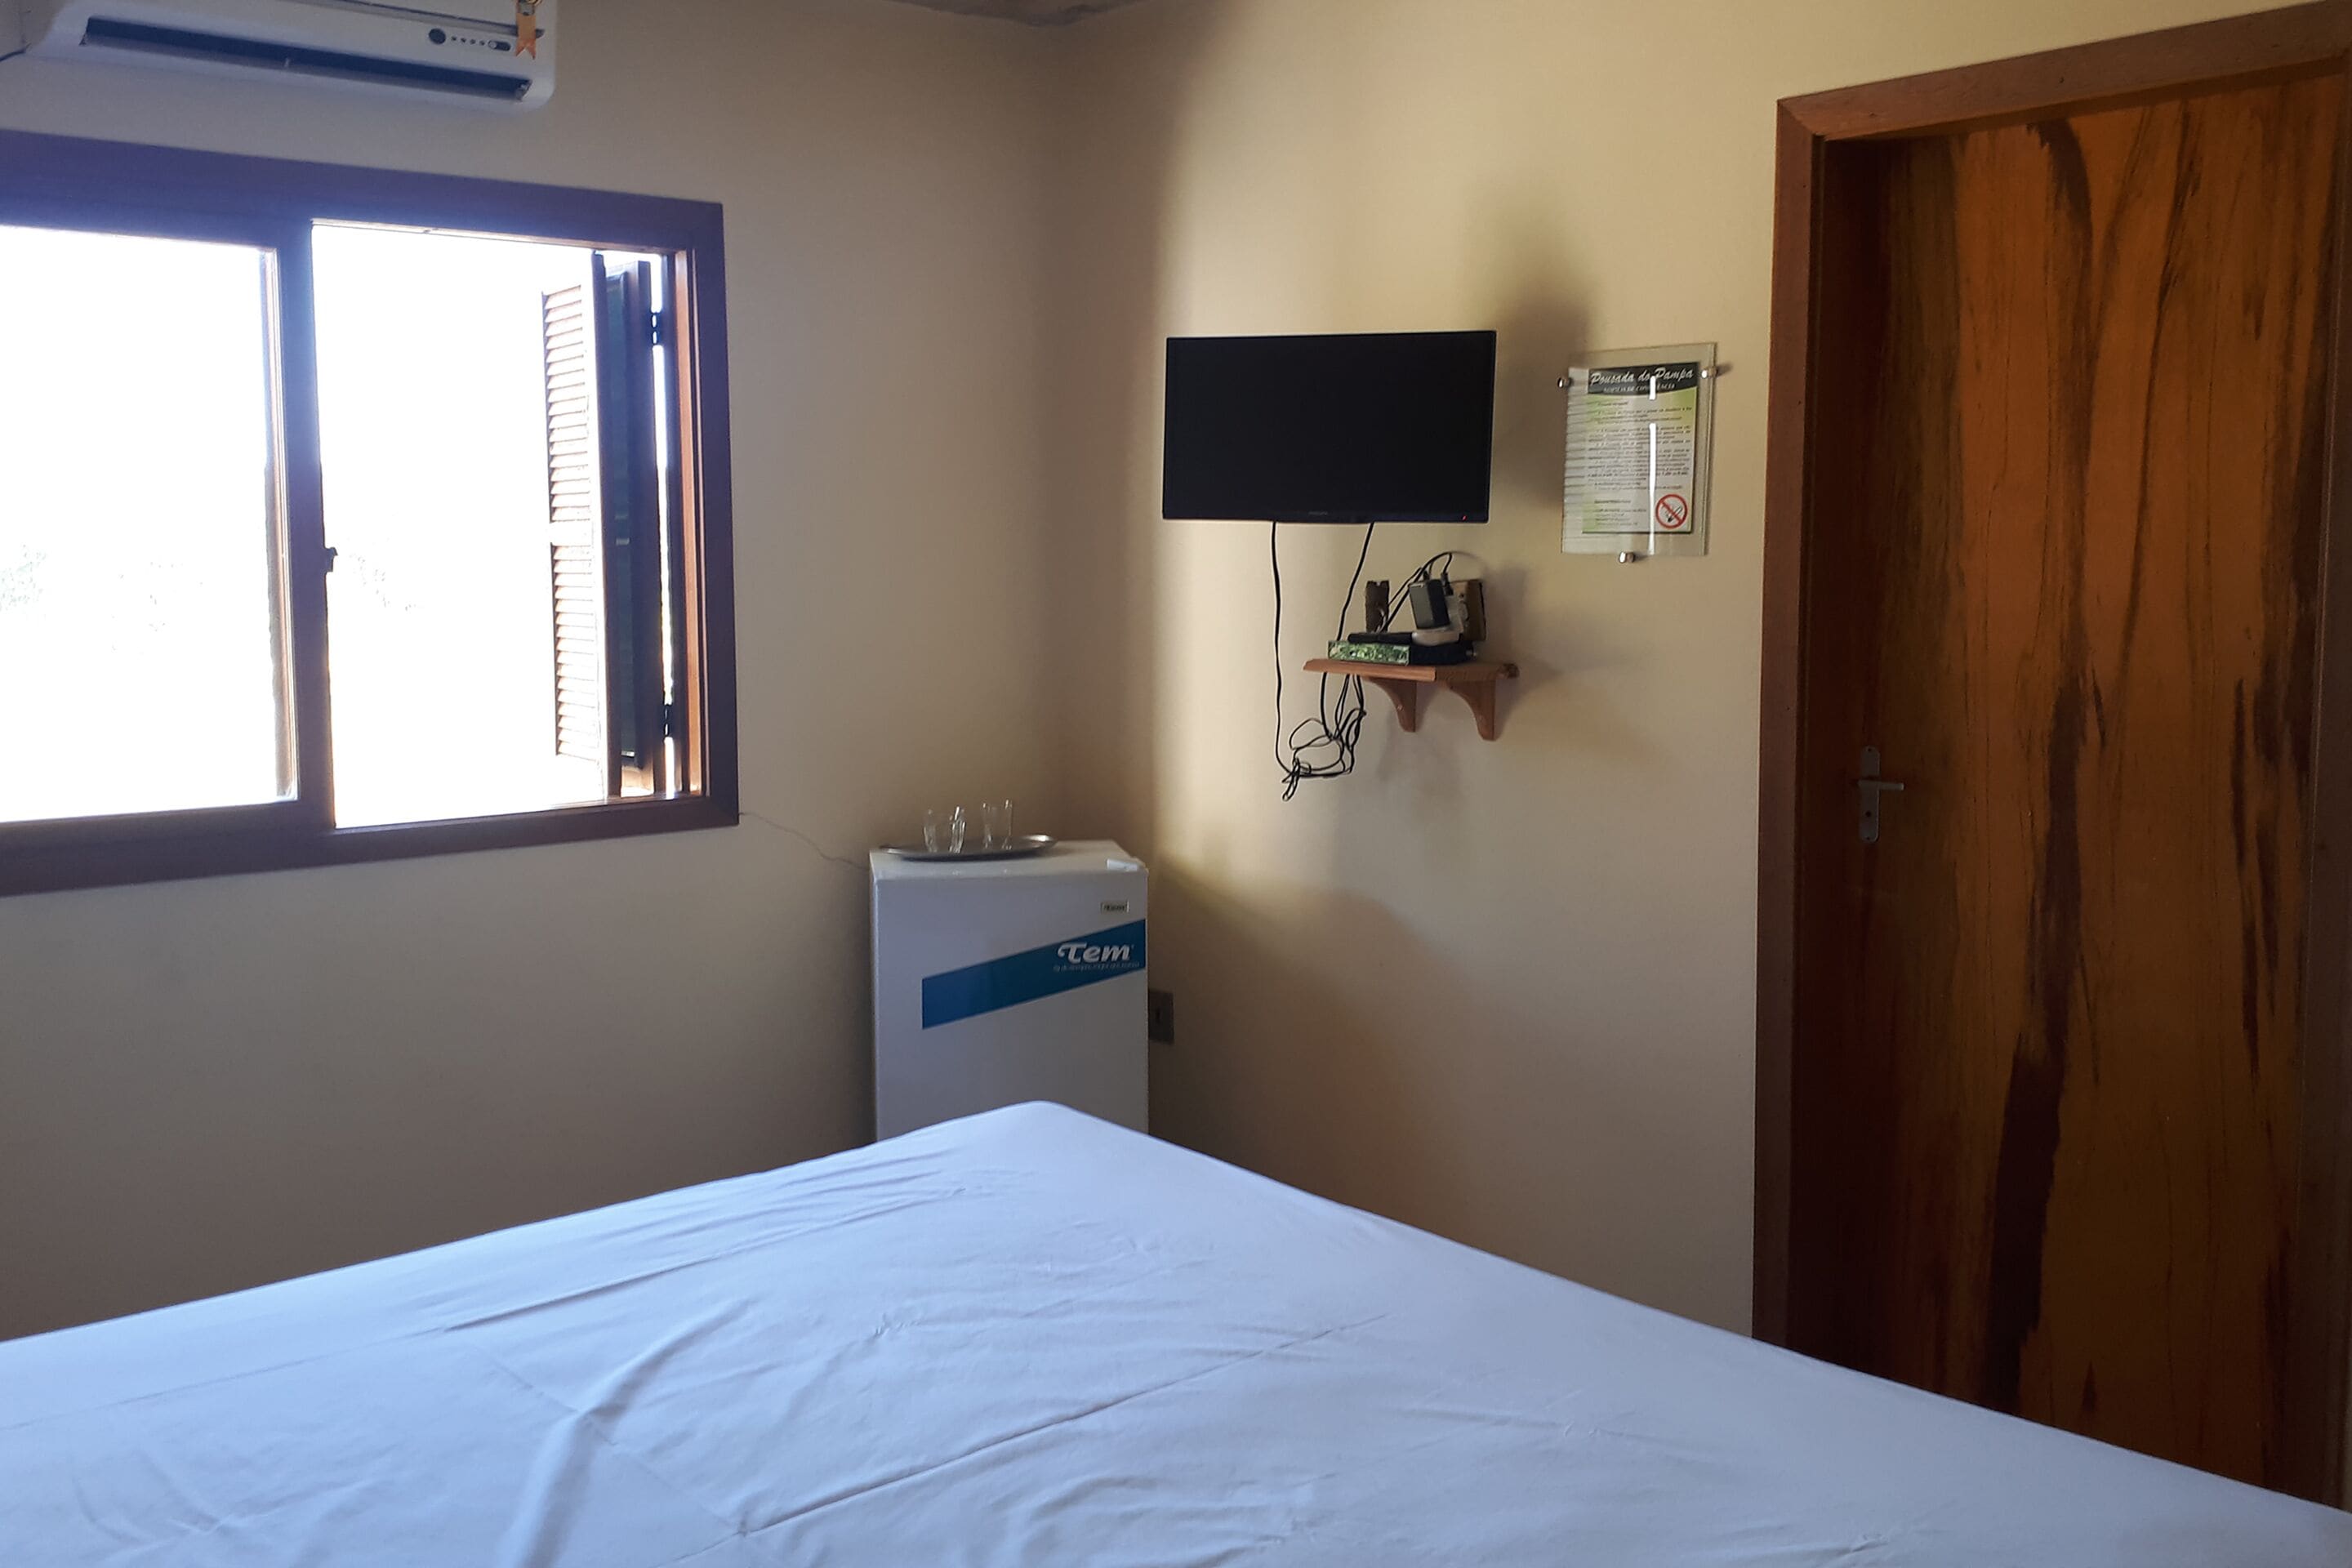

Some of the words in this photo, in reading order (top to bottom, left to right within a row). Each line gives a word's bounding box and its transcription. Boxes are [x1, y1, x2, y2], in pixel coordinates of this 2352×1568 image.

[1590, 372, 1634, 385] Pousada
[1637, 370, 1650, 381] do
[1655, 367, 1693, 382] Pampa
[1058, 942, 1129, 963] Tem
